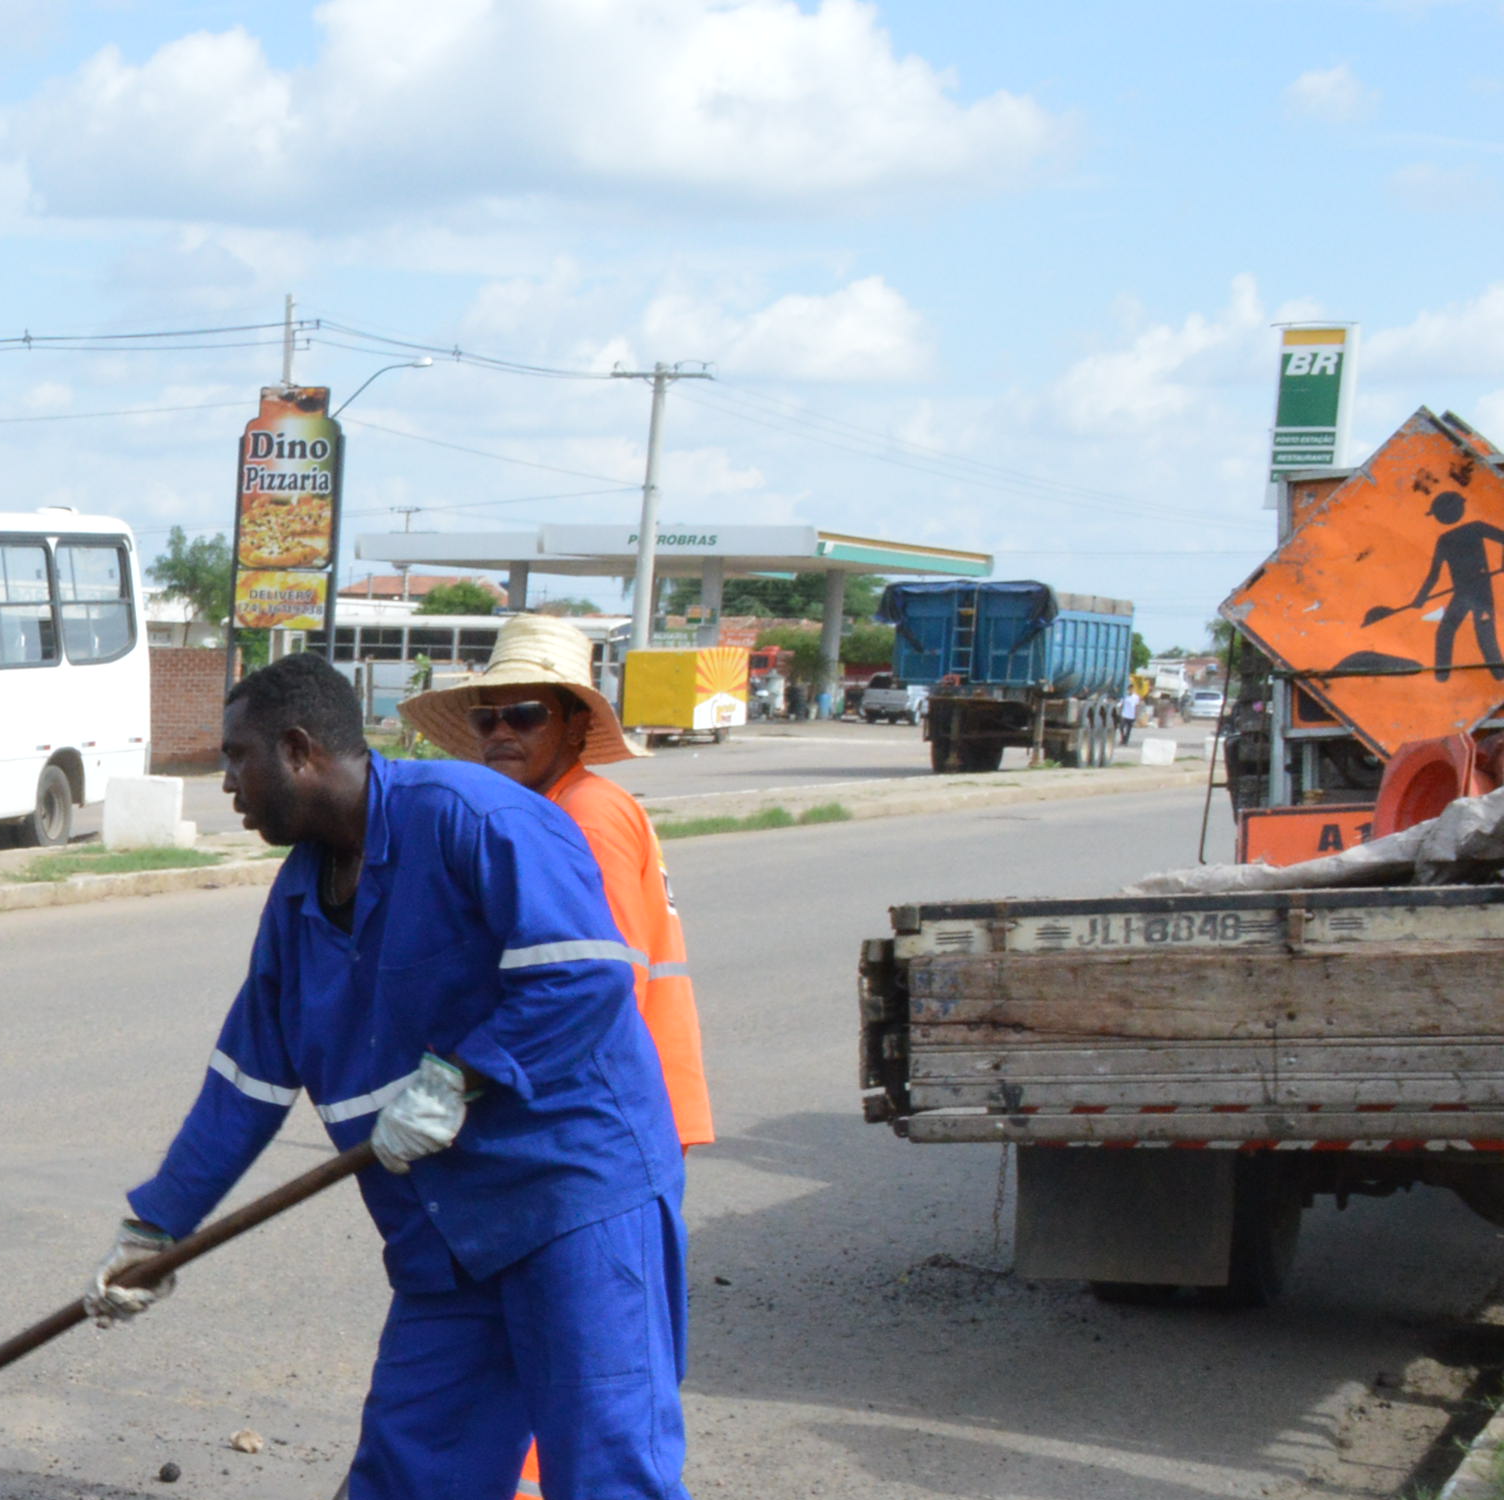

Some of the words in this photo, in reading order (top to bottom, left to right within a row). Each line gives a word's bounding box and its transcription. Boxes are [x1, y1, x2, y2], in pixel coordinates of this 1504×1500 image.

[1285, 350, 1339, 376] BR
[248, 430, 329, 460] Dino
[244, 465, 330, 493] Pizzaria
[627, 534, 718, 546] PROBRAS
[249, 589, 313, 600] DELIVERY
[1317, 824, 1344, 852] A
